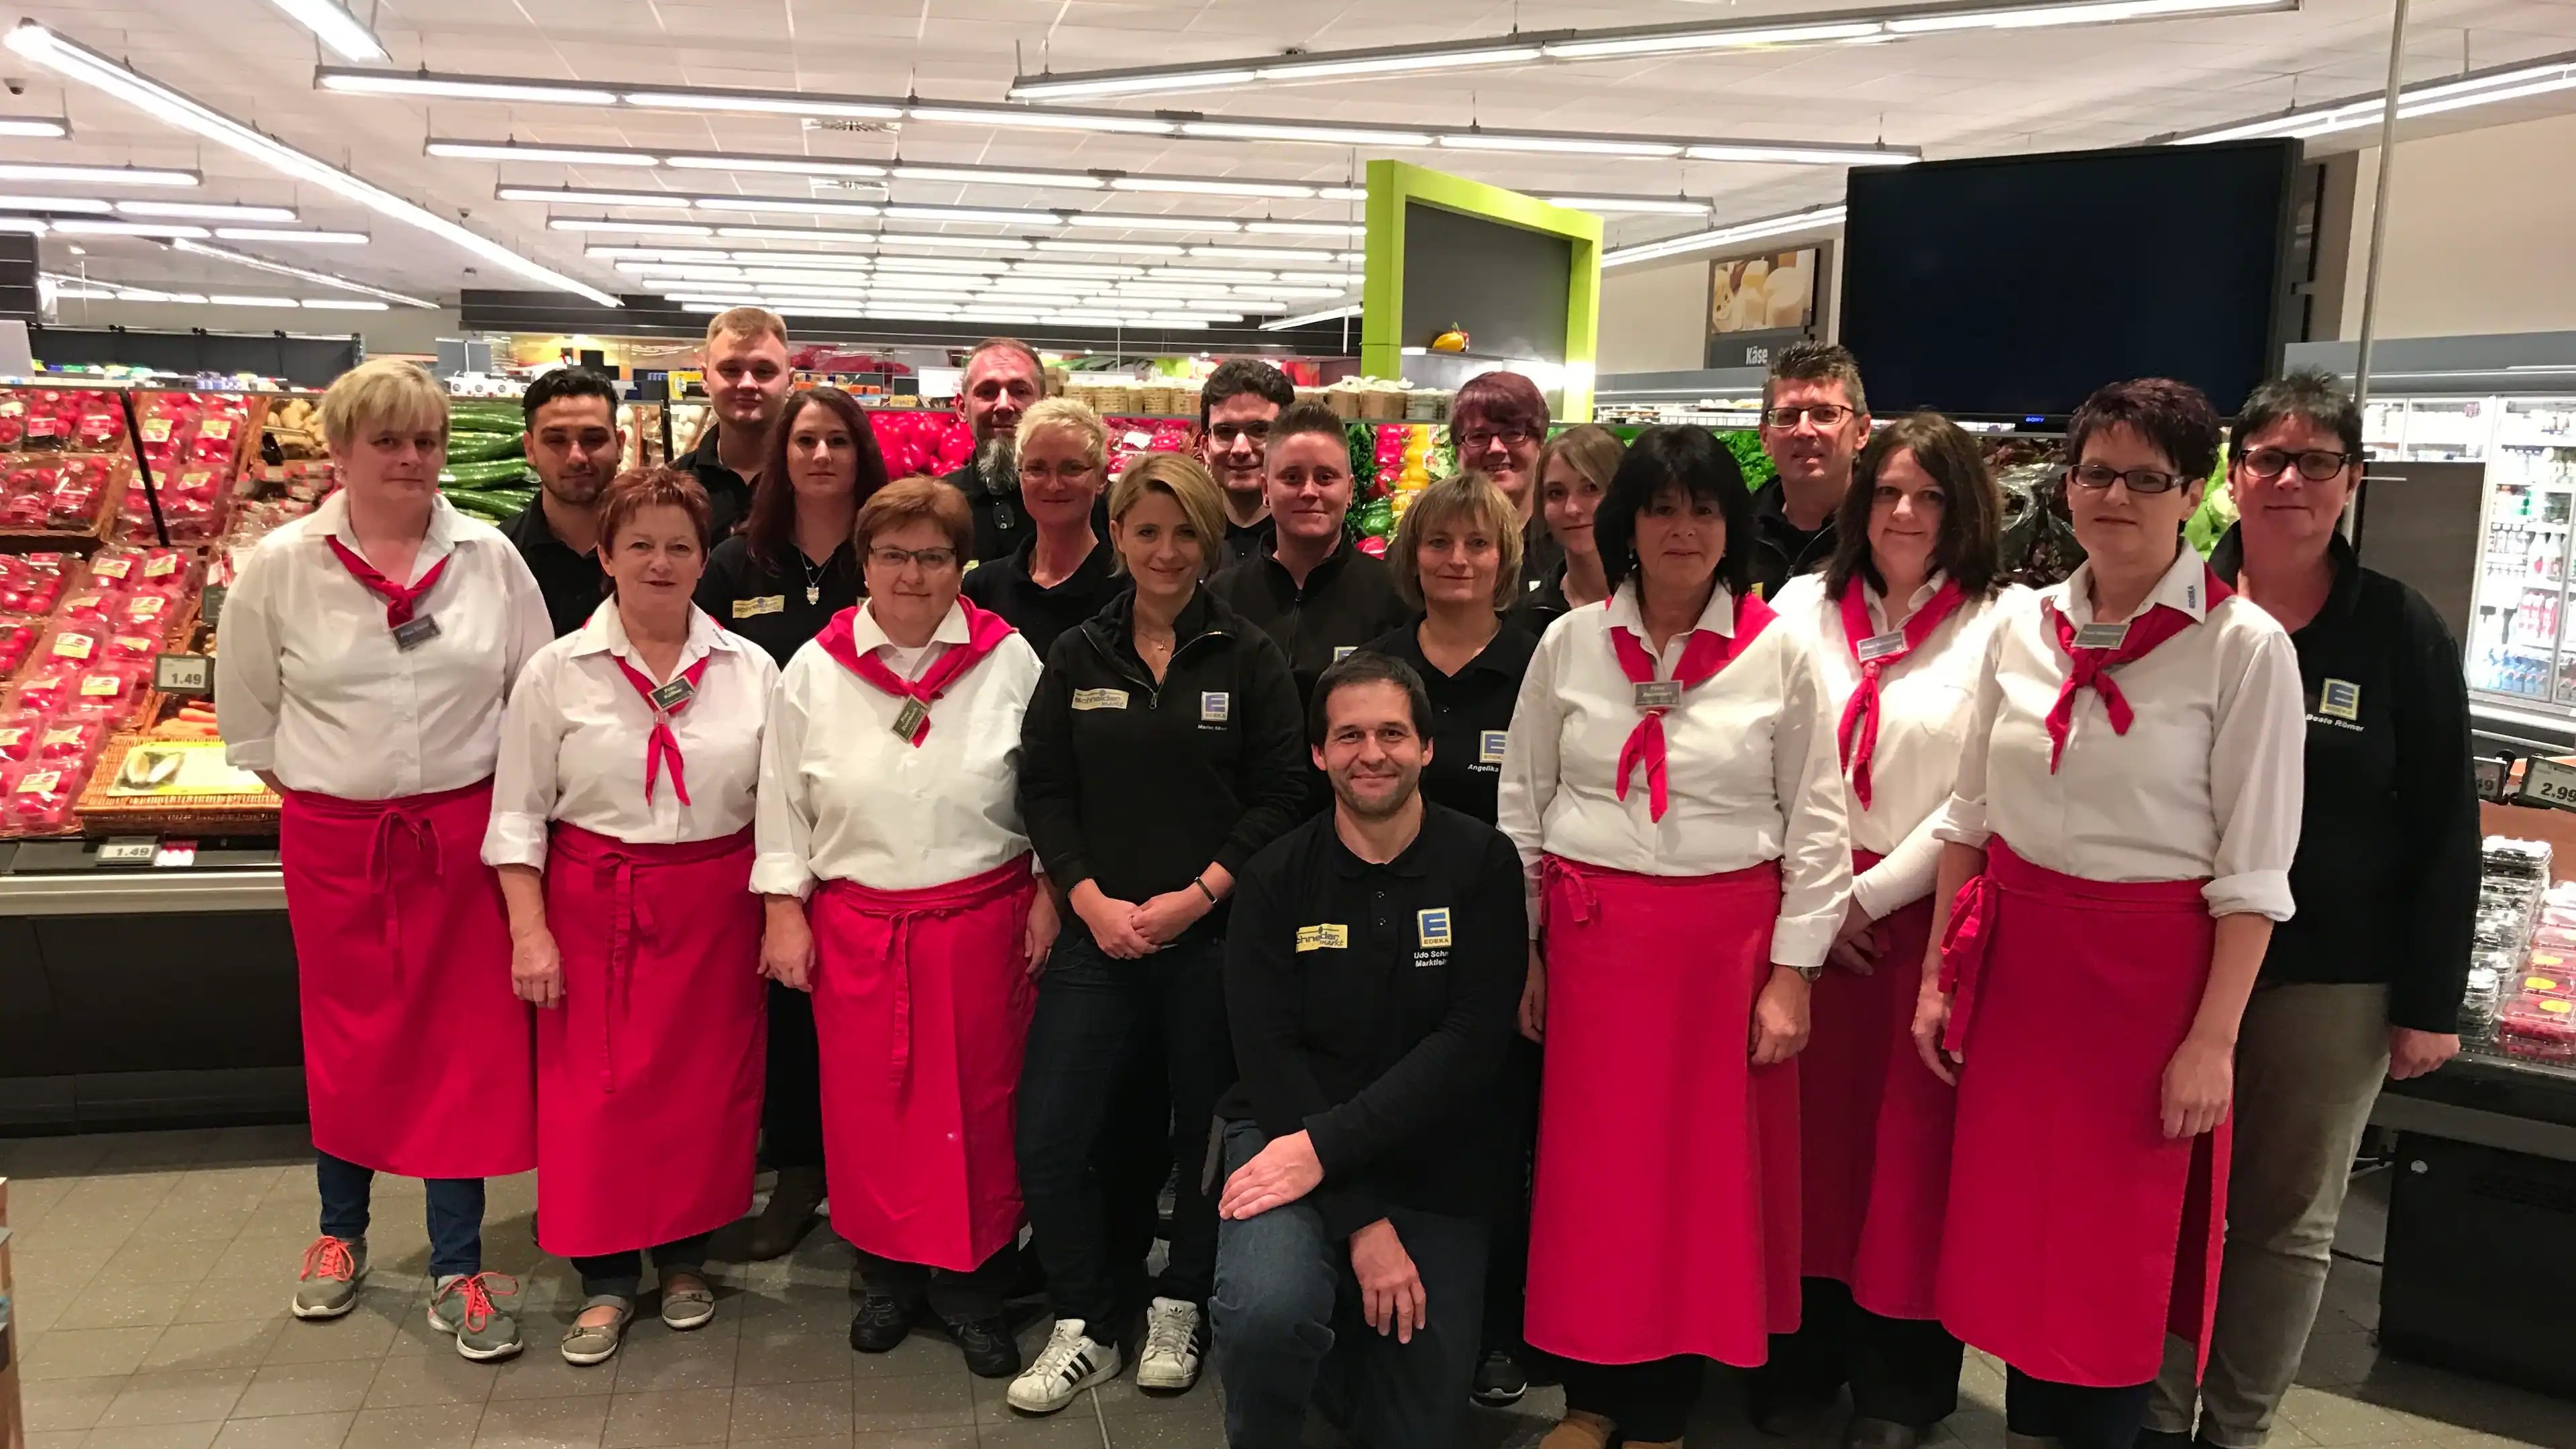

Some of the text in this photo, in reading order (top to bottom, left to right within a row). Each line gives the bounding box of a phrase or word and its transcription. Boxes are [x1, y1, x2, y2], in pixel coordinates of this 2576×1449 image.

[1746, 345, 1768, 365] Käse
[172, 673, 202, 685] 1.49
[2306, 714, 2333, 724] Beate
[1468, 763, 1499, 772] Angelika
[2540, 782, 2576, 802] 2.99
[116, 847, 150, 856] 1.49
[1421, 912, 1448, 937] E
[1413, 951, 1430, 959] Udo
